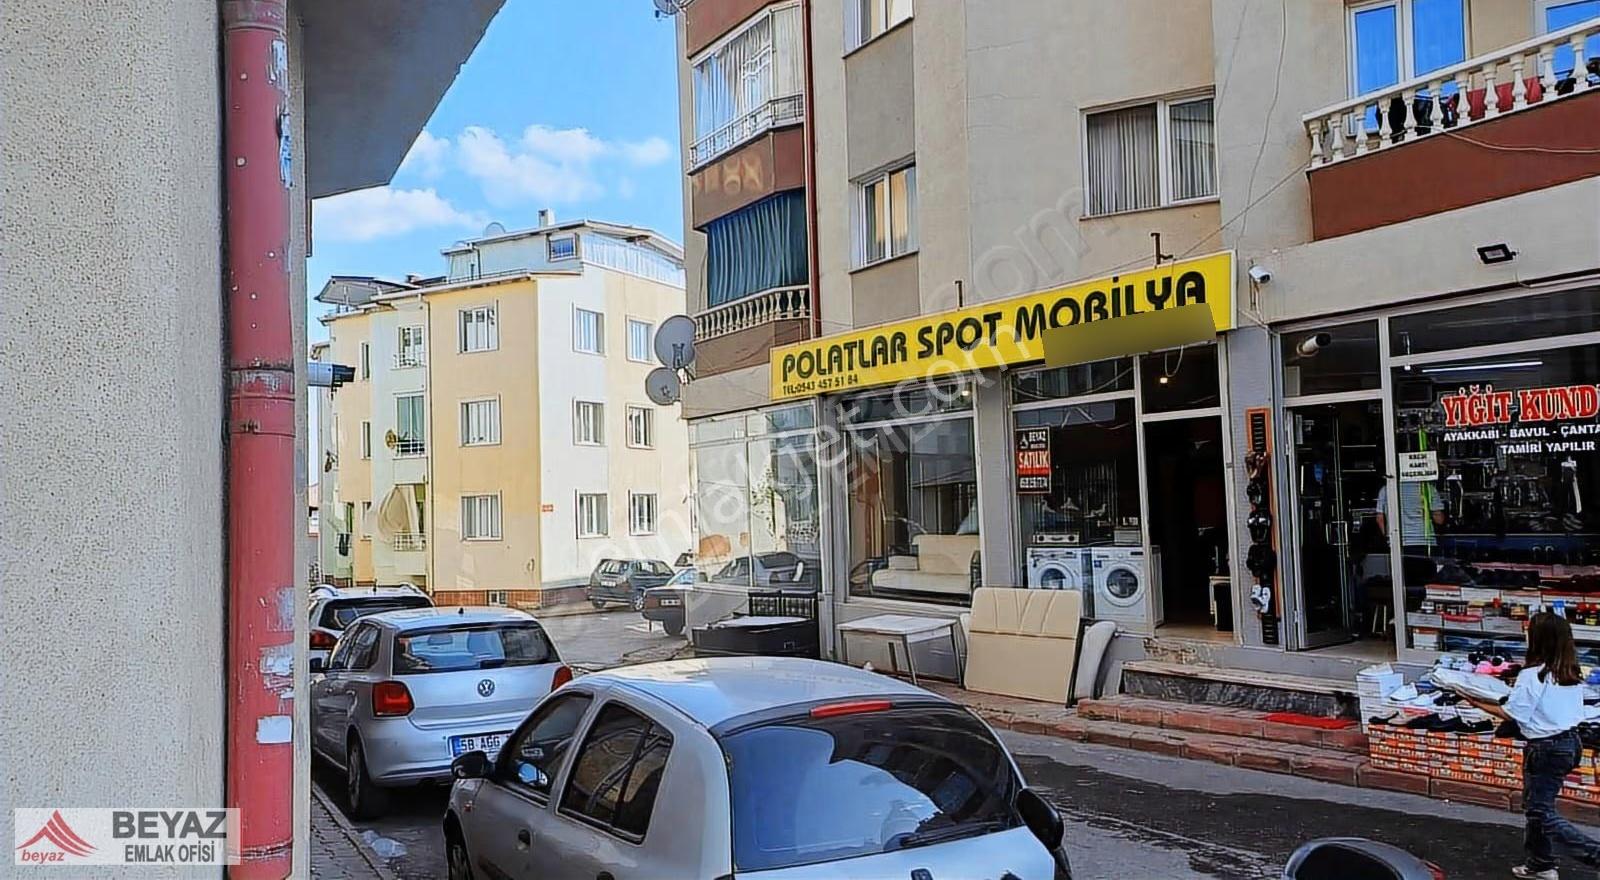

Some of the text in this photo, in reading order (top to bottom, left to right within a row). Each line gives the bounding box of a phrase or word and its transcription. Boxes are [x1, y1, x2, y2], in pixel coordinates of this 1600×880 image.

[782, 271, 1206, 383] POLATLAR SPOT MOBİLYA
[818, 378, 832, 389] 457
[835, 376, 845, 387] 51
[1440, 384, 1600, 427] YİĞİT KUND
[1510, 427, 1550, 438] BAVUL
[1560, 424, 1600, 438] ÇANTA
[1501, 440, 1596, 454] TAMİRİ YAPILIR
[1018, 450, 1049, 469] SATILIK
